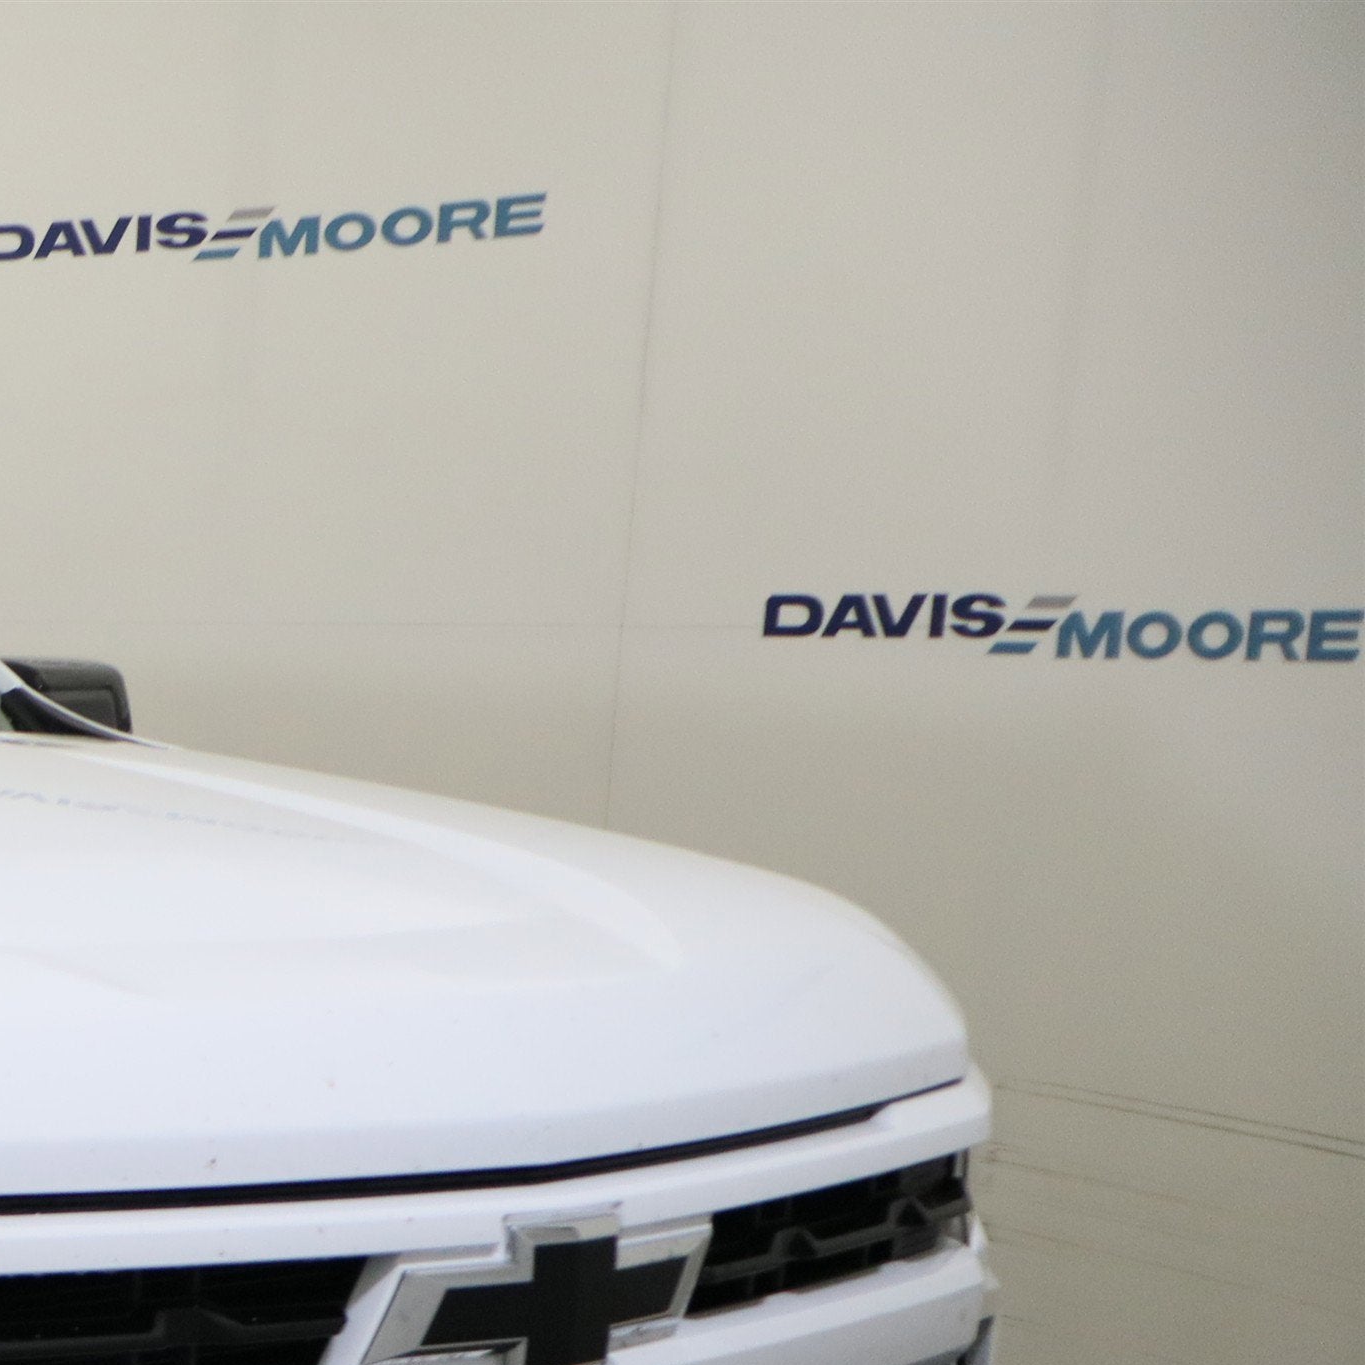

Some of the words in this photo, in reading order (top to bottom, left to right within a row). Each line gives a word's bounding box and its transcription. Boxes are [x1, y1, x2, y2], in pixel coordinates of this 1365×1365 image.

[256, 191, 548, 261] MOORE
[762, 593, 1007, 640] DAVIS
[1054, 607, 1365, 663] MOORE
